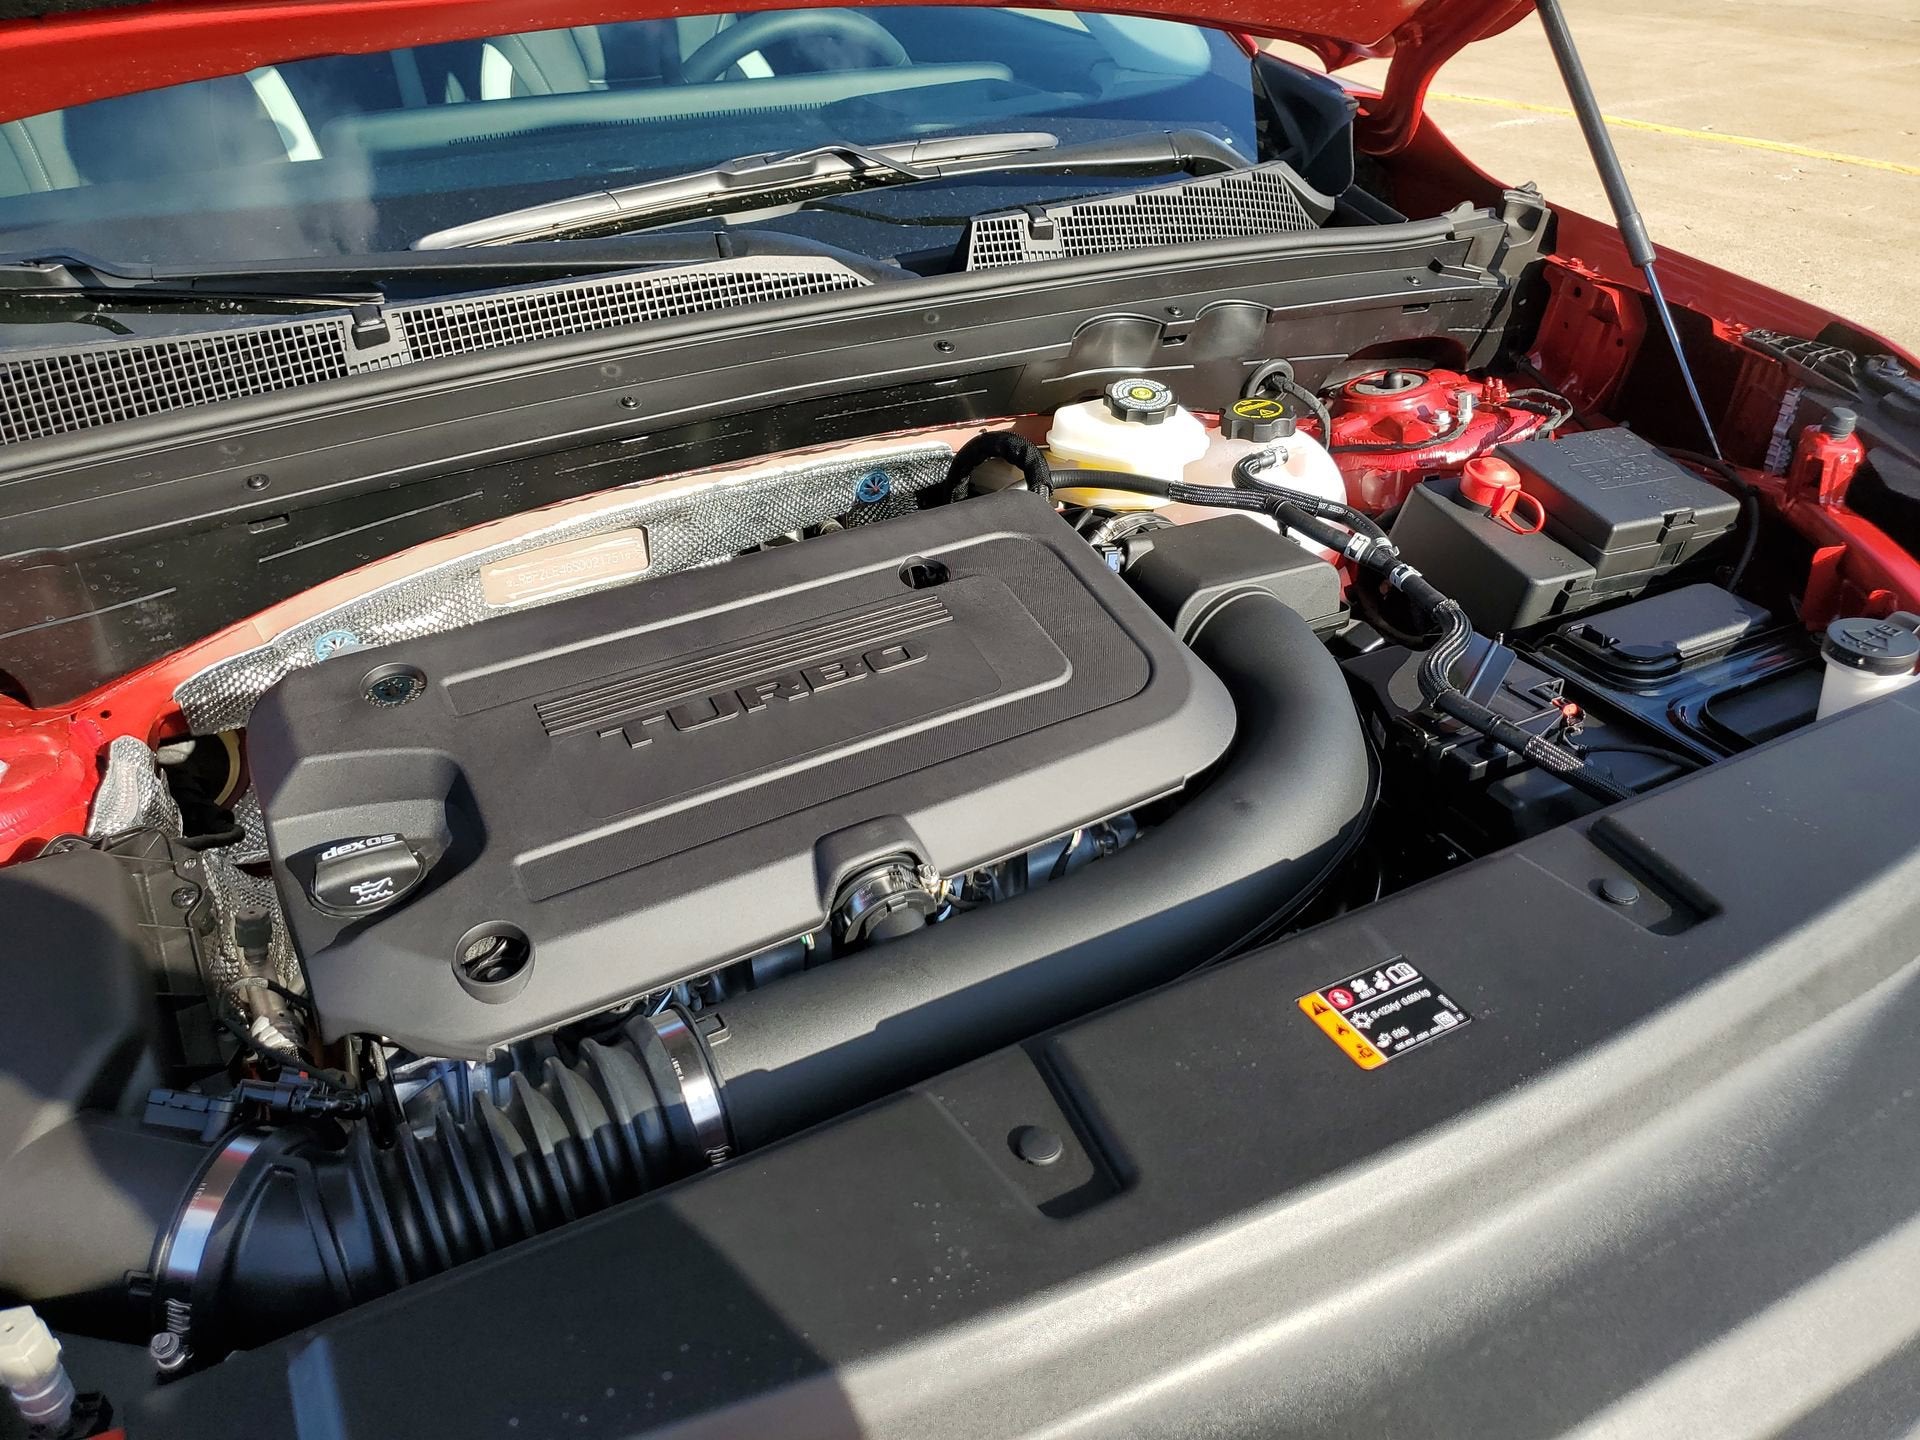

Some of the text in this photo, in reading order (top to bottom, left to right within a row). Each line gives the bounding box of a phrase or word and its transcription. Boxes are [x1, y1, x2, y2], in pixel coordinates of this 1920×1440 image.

[597, 643, 929, 749] TURBO
[321, 833, 397, 861] dexos
[1359, 987, 1377, 1000] AUTO
[1419, 988, 1432, 999] kg
[1391, 1026, 1410, 1040] PAG
